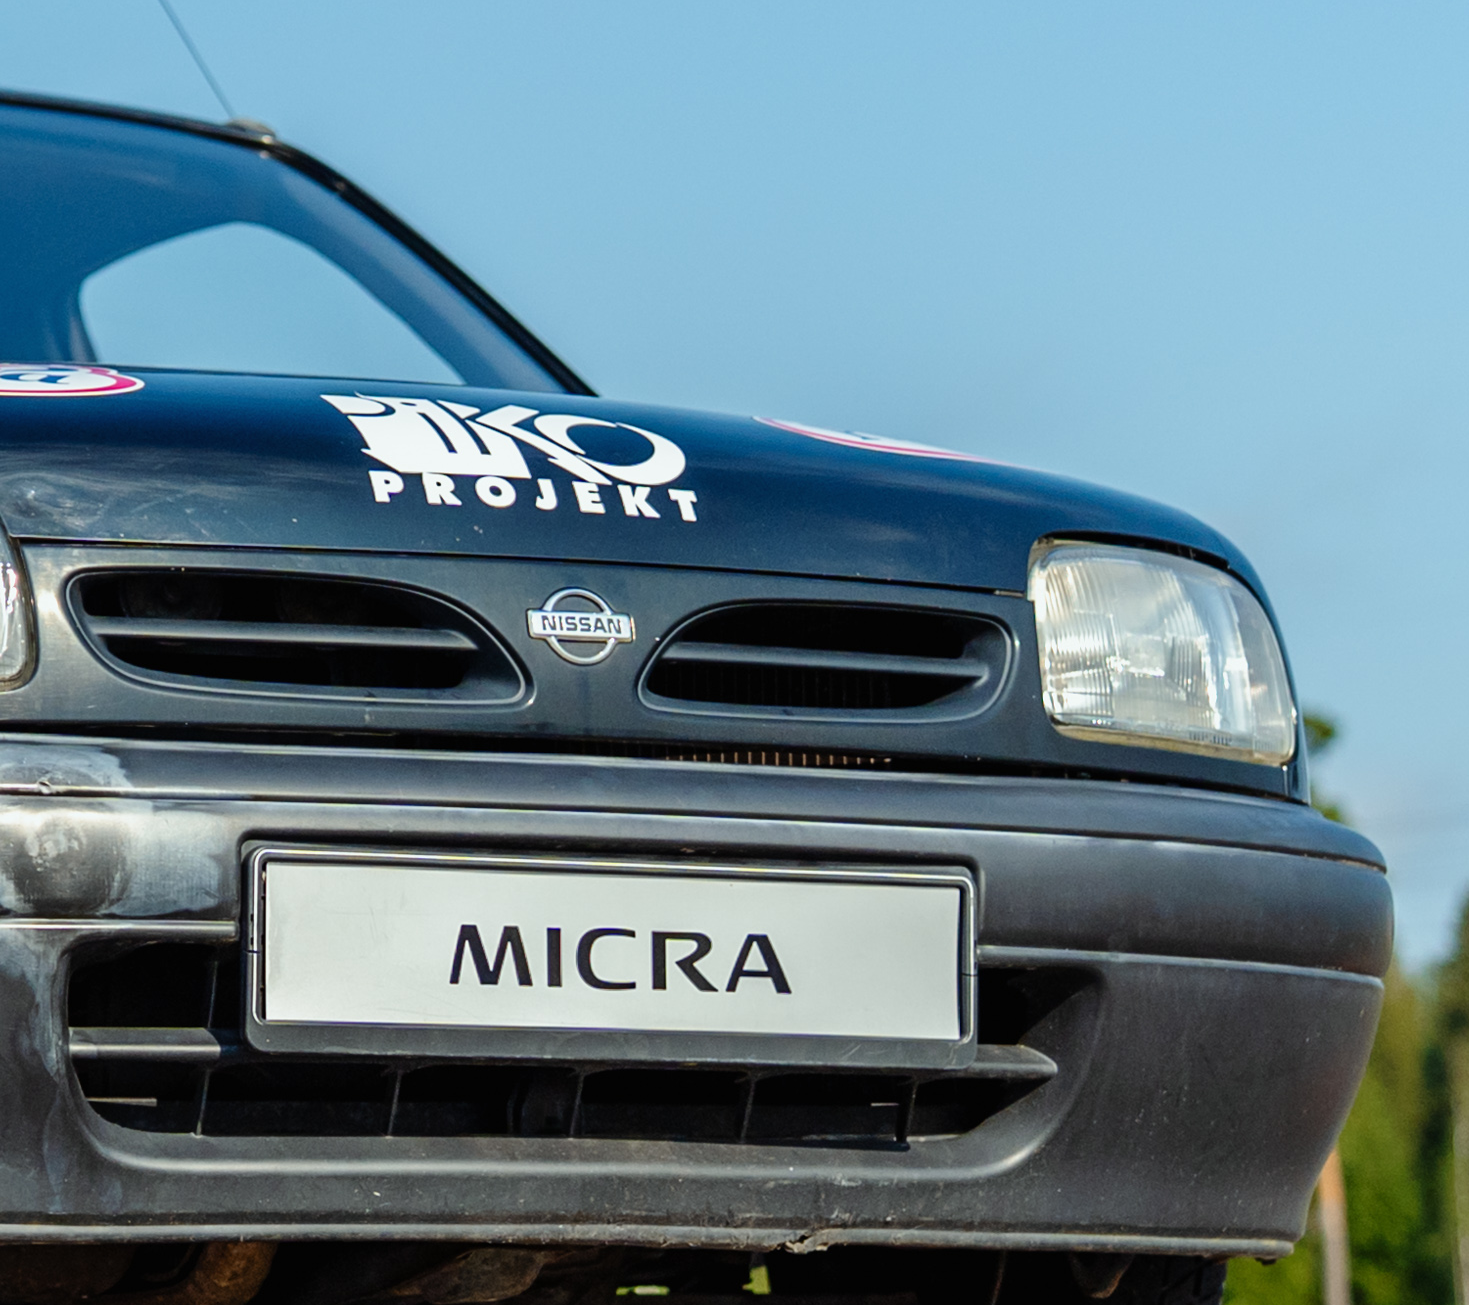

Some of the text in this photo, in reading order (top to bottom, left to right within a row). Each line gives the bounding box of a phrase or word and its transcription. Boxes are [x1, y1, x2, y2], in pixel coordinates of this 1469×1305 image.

[368, 469, 698, 522] PROJEKT
[540, 614, 622, 634] NISSAN
[448, 924, 792, 995] MICRA
